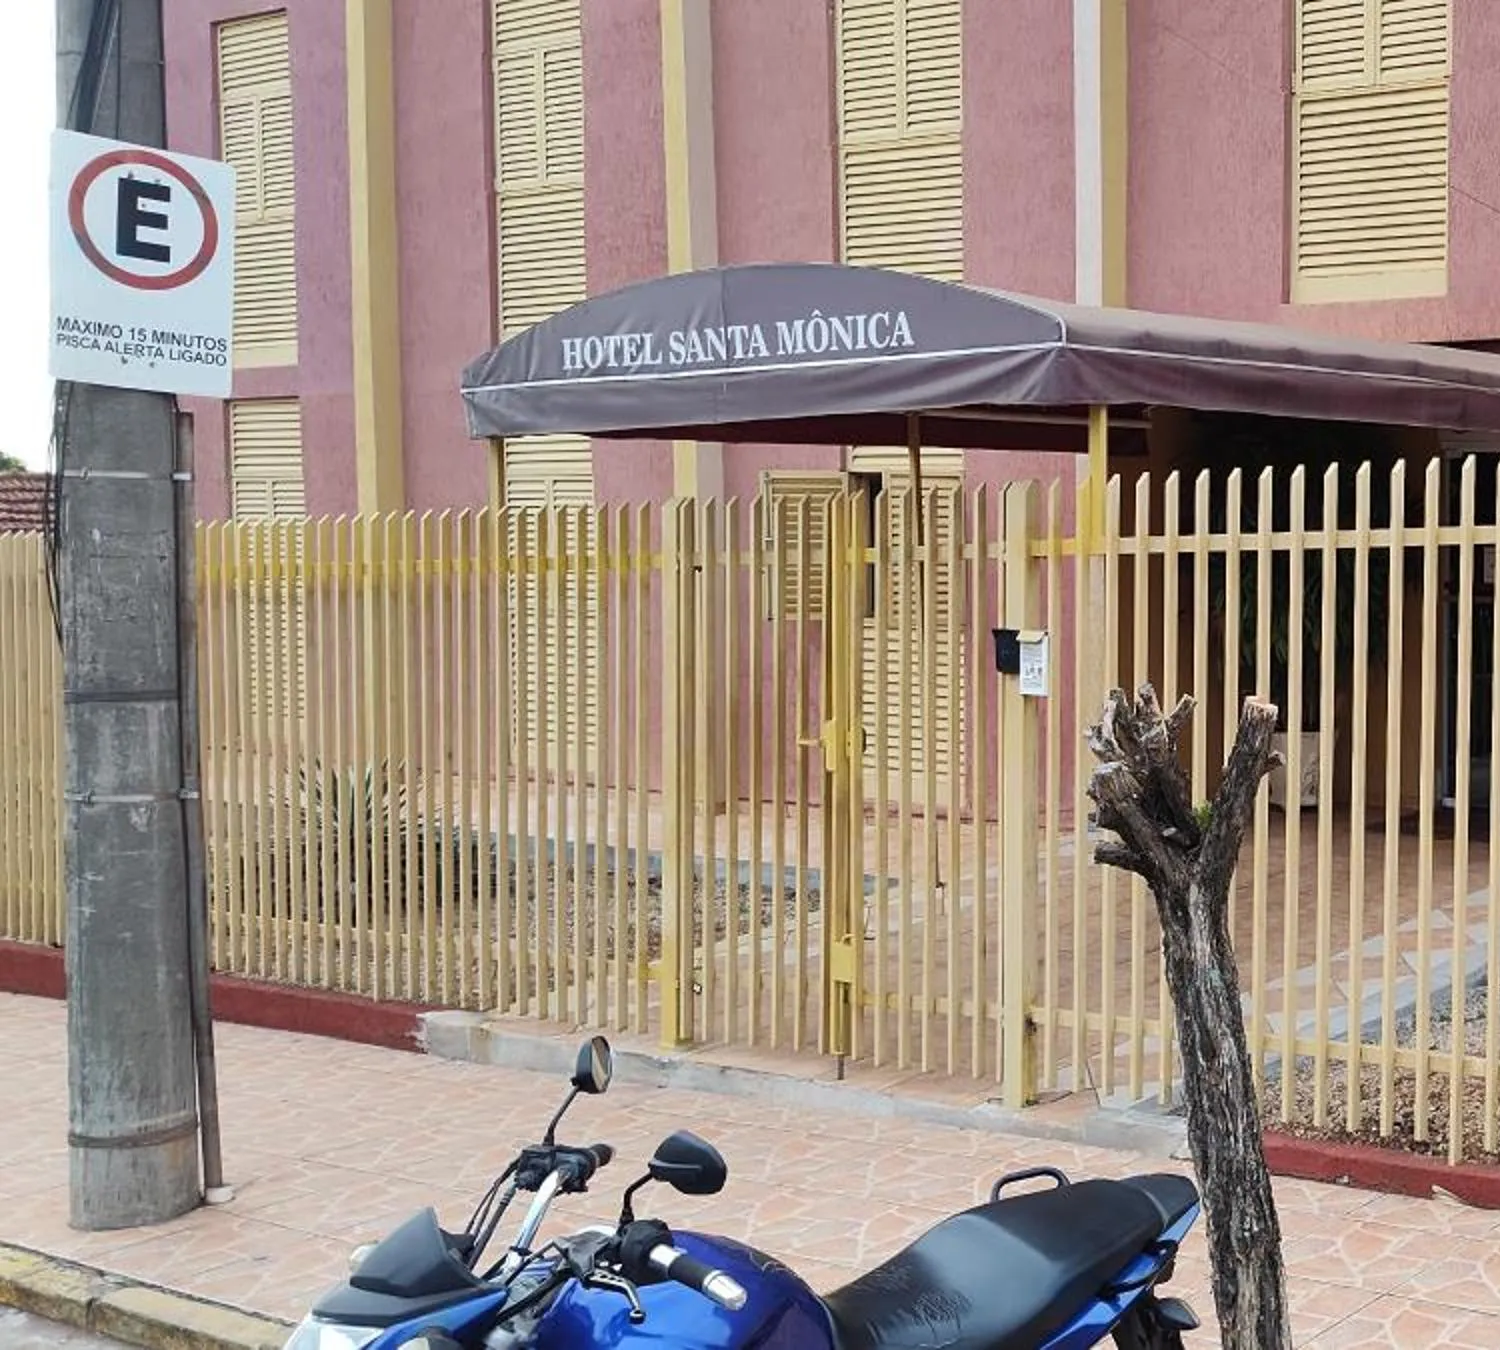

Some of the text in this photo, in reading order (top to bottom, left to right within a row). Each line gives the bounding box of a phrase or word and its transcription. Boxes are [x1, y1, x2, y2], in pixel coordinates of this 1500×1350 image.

[116, 177, 171, 263] E
[56, 333, 228, 367] PISCA ALERTA LIGADO
[129, 327, 147, 343] 15
[151, 329, 228, 353] MINUTOS
[561, 309, 916, 371] HOTEL SANTA MÔNICA
